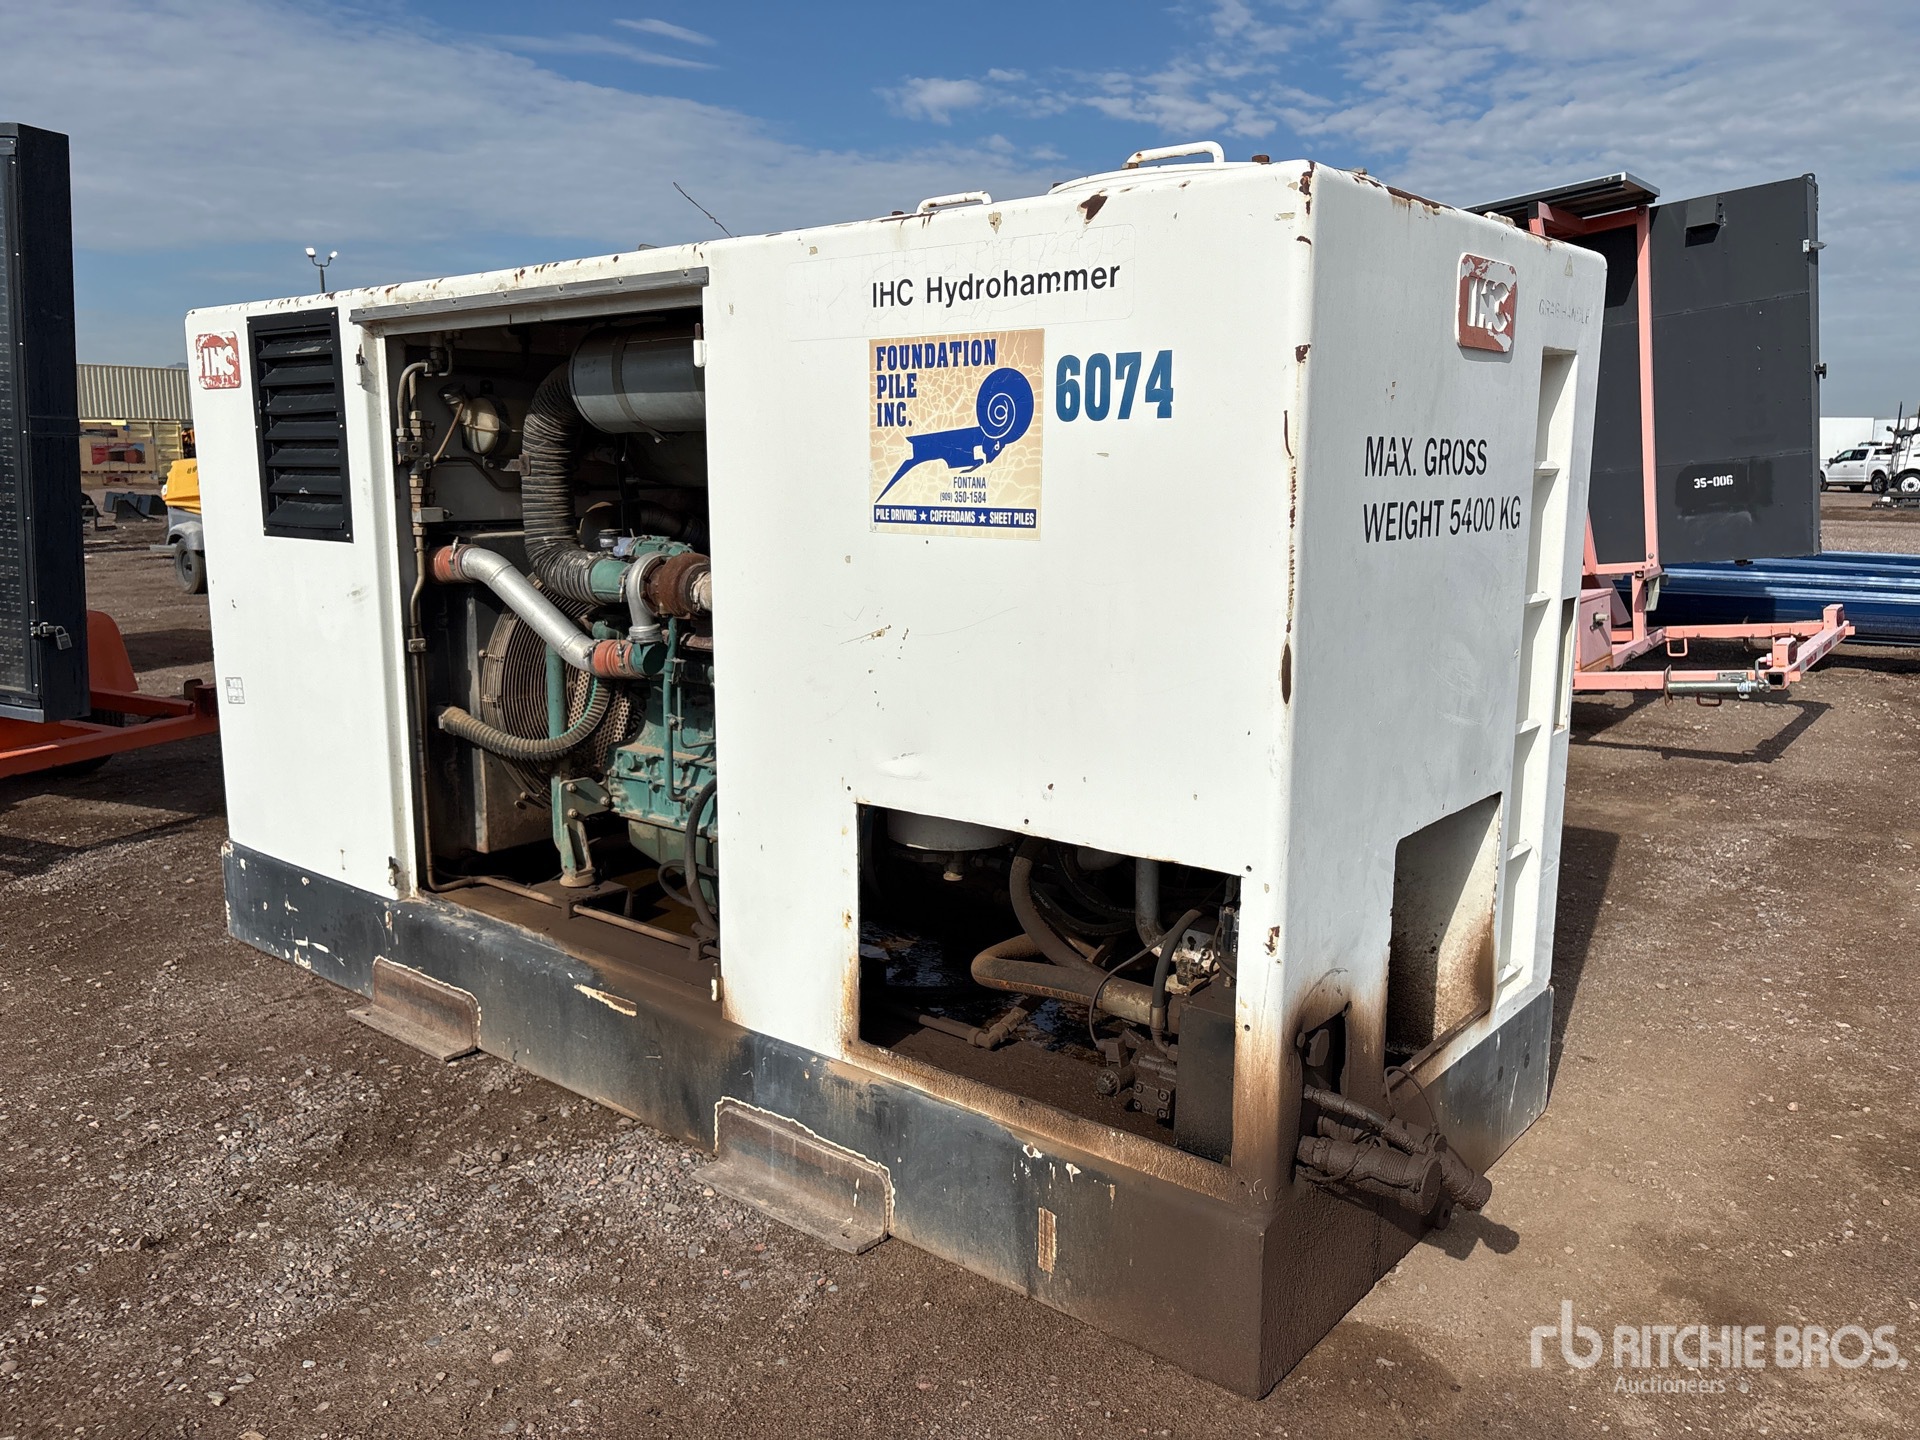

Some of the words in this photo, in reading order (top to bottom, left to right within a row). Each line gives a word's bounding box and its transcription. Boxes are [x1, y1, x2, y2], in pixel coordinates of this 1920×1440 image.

[872, 278, 914, 308] IHC
[926, 265, 1121, 308] Hydrohammer
[876, 338, 996, 371] FOUNDATION
[876, 373, 917, 399] PILE
[1056, 350, 1174, 422] 6074
[876, 402, 913, 428] INC.
[1365, 436, 1416, 477] MAX.
[1424, 437, 1487, 477] GROSS
[953, 476, 987, 489] FONTANA
[1693, 474, 1734, 489] 35-006
[939, 492, 953, 503] (909)
[954, 491, 987, 504] 350-1584
[875, 508, 890, 520] PILE
[890, 509, 917, 522] DRIVING
[929, 510, 976, 524] COFFERDAMS
[989, 511, 1013, 525] SHEET
[1013, 512, 1035, 526] PILES
[1363, 499, 1445, 543] WEIGHT
[1449, 497, 1495, 536] 5400
[1499, 495, 1521, 531] KG
